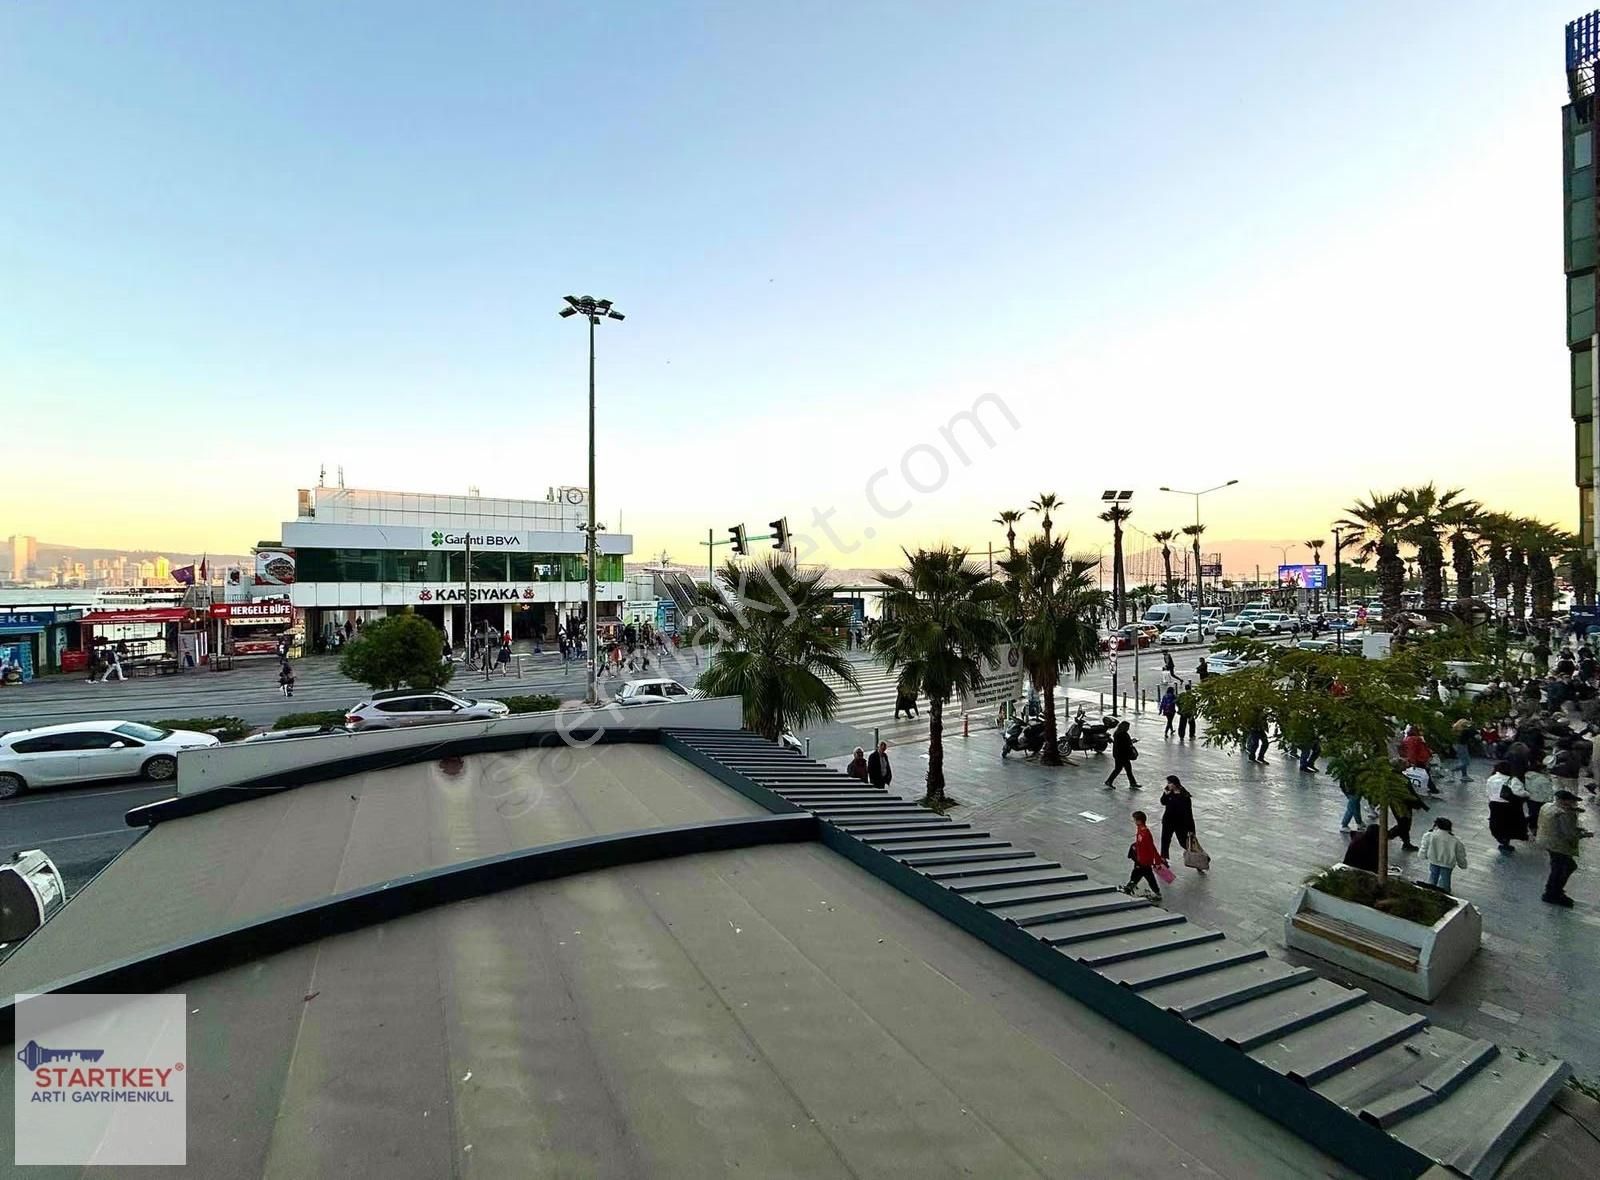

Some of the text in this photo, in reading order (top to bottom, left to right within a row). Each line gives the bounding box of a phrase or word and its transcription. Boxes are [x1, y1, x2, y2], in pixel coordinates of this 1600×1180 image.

[486, 536, 520, 545] BBVA
[435, 588, 520, 602] KARŞIYAKA
[230, 605, 269, 615] HERGELE
[269, 603, 291, 614] BÜFE
